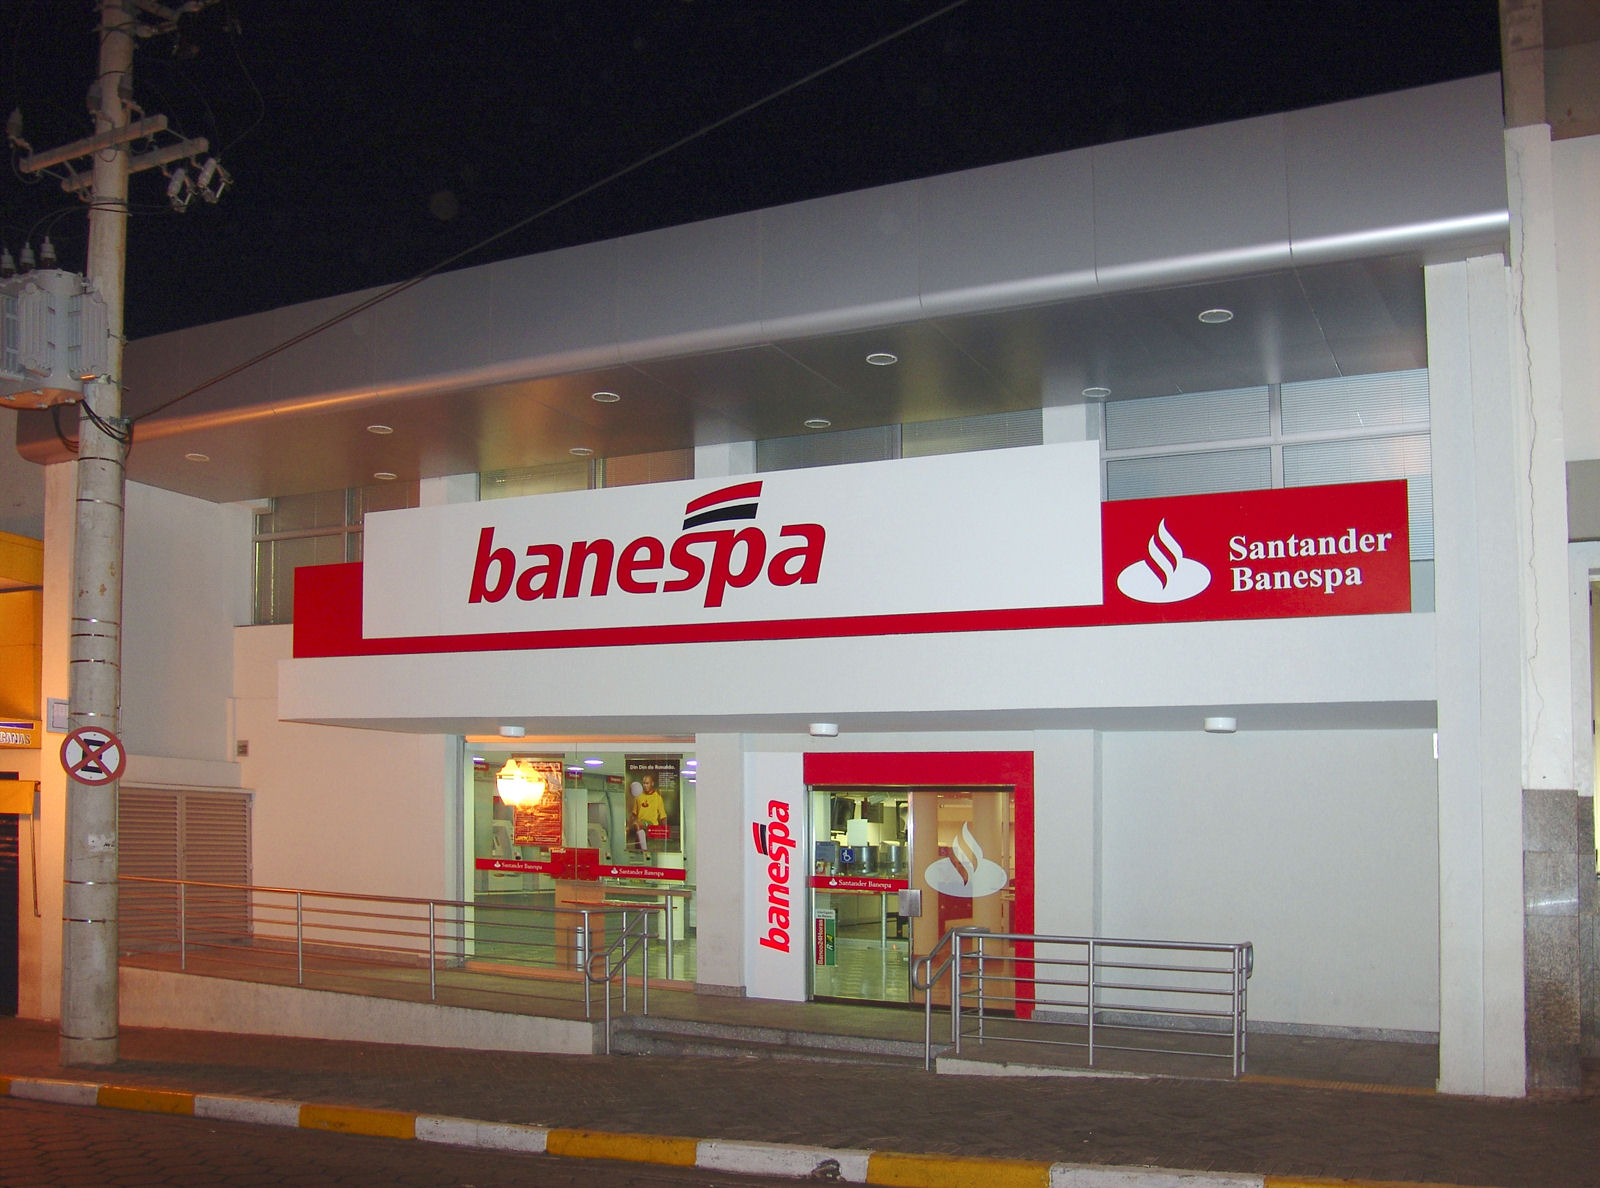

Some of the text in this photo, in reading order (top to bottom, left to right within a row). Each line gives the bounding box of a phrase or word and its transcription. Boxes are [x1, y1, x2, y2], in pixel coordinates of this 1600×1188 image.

[1229, 527, 1392, 562] Santander
[468, 522, 826, 608] banespa
[1230, 566, 1363, 595] Banespa
[501, 861, 523, 869] Santander
[760, 799, 796, 954] banespa
[868, 881, 892, 890] Banespa
